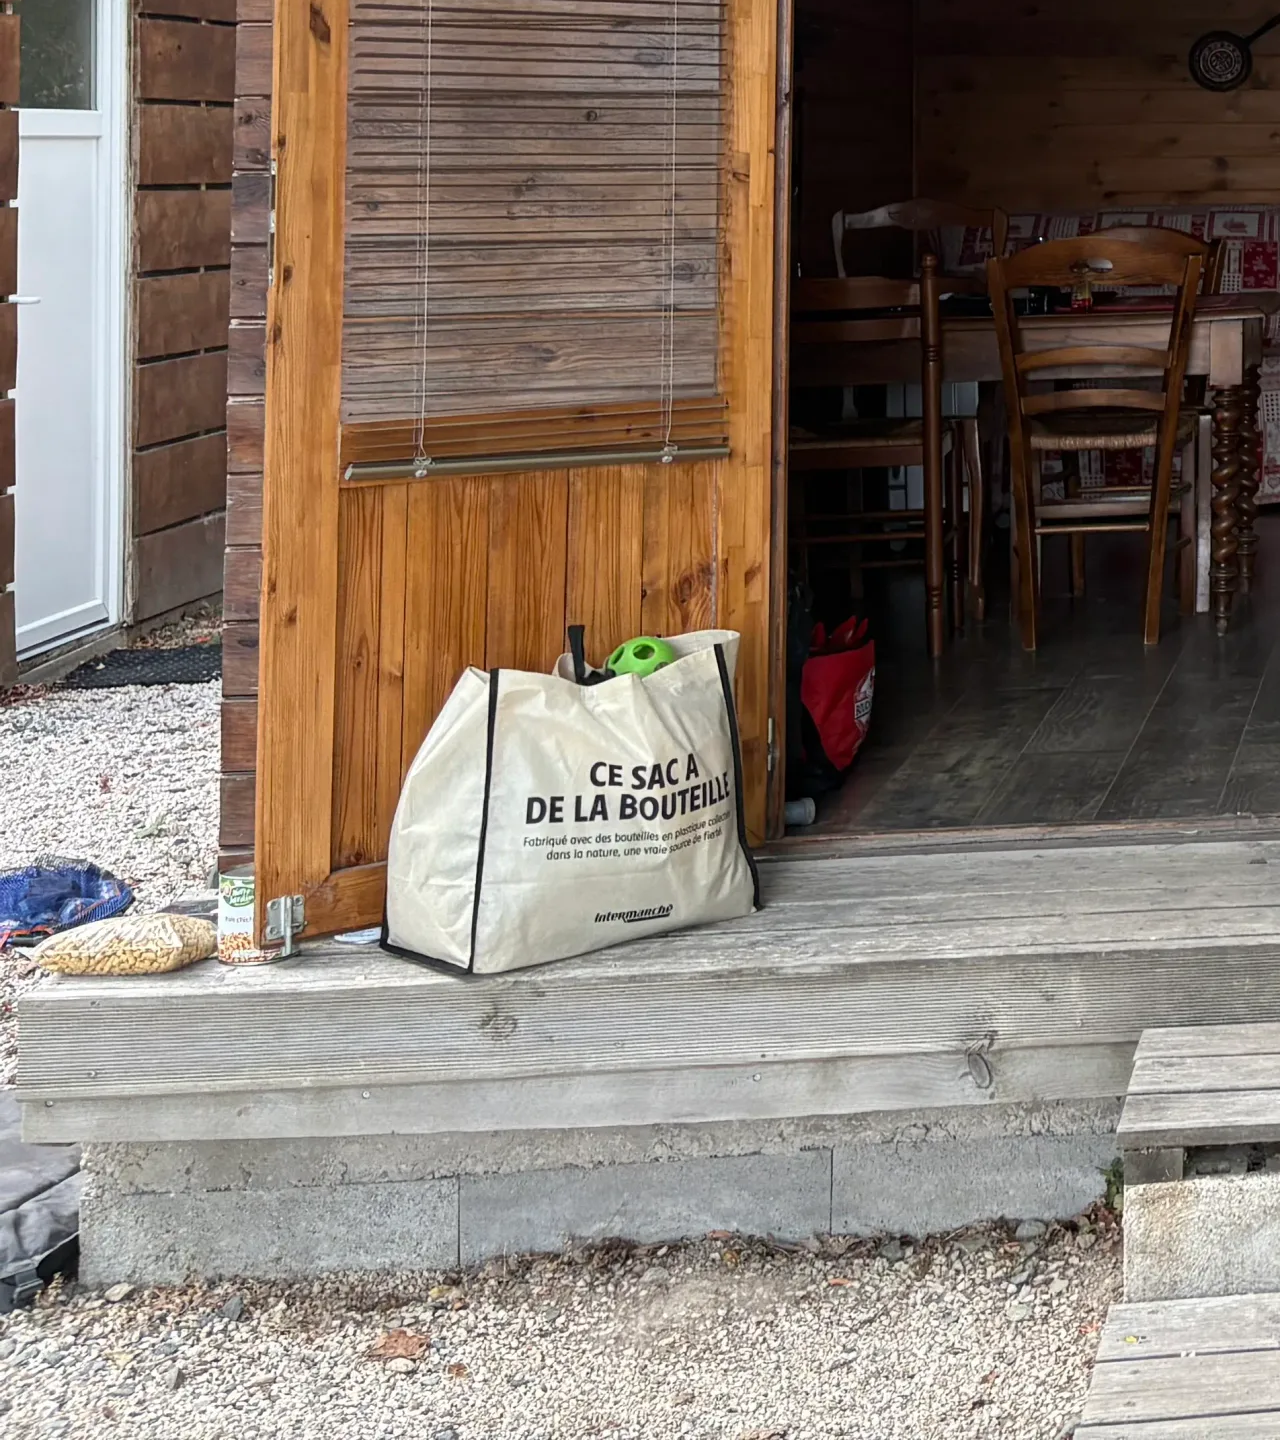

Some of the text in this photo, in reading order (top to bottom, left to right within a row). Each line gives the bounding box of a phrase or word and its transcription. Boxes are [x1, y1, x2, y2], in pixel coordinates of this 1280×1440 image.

[590, 753, 699, 790] CE SAC A
[526, 772, 730, 824] DE LA BOUTEILLE
[523, 835, 568, 848] Fabriqué
[570, 836, 592, 845] avec
[595, 833, 612, 843] des
[615, 830, 659, 843] bouteilles
[662, 832, 673, 842] en
[675, 820, 707, 840] plastique
[546, 848, 571, 860] dans
[574, 848, 583, 859] la
[586, 845, 621, 858] nature,
[624, 847, 641, 857] une
[644, 844, 668, 855] vraie
[669, 838, 692, 853] source
[692, 833, 702, 844] de
